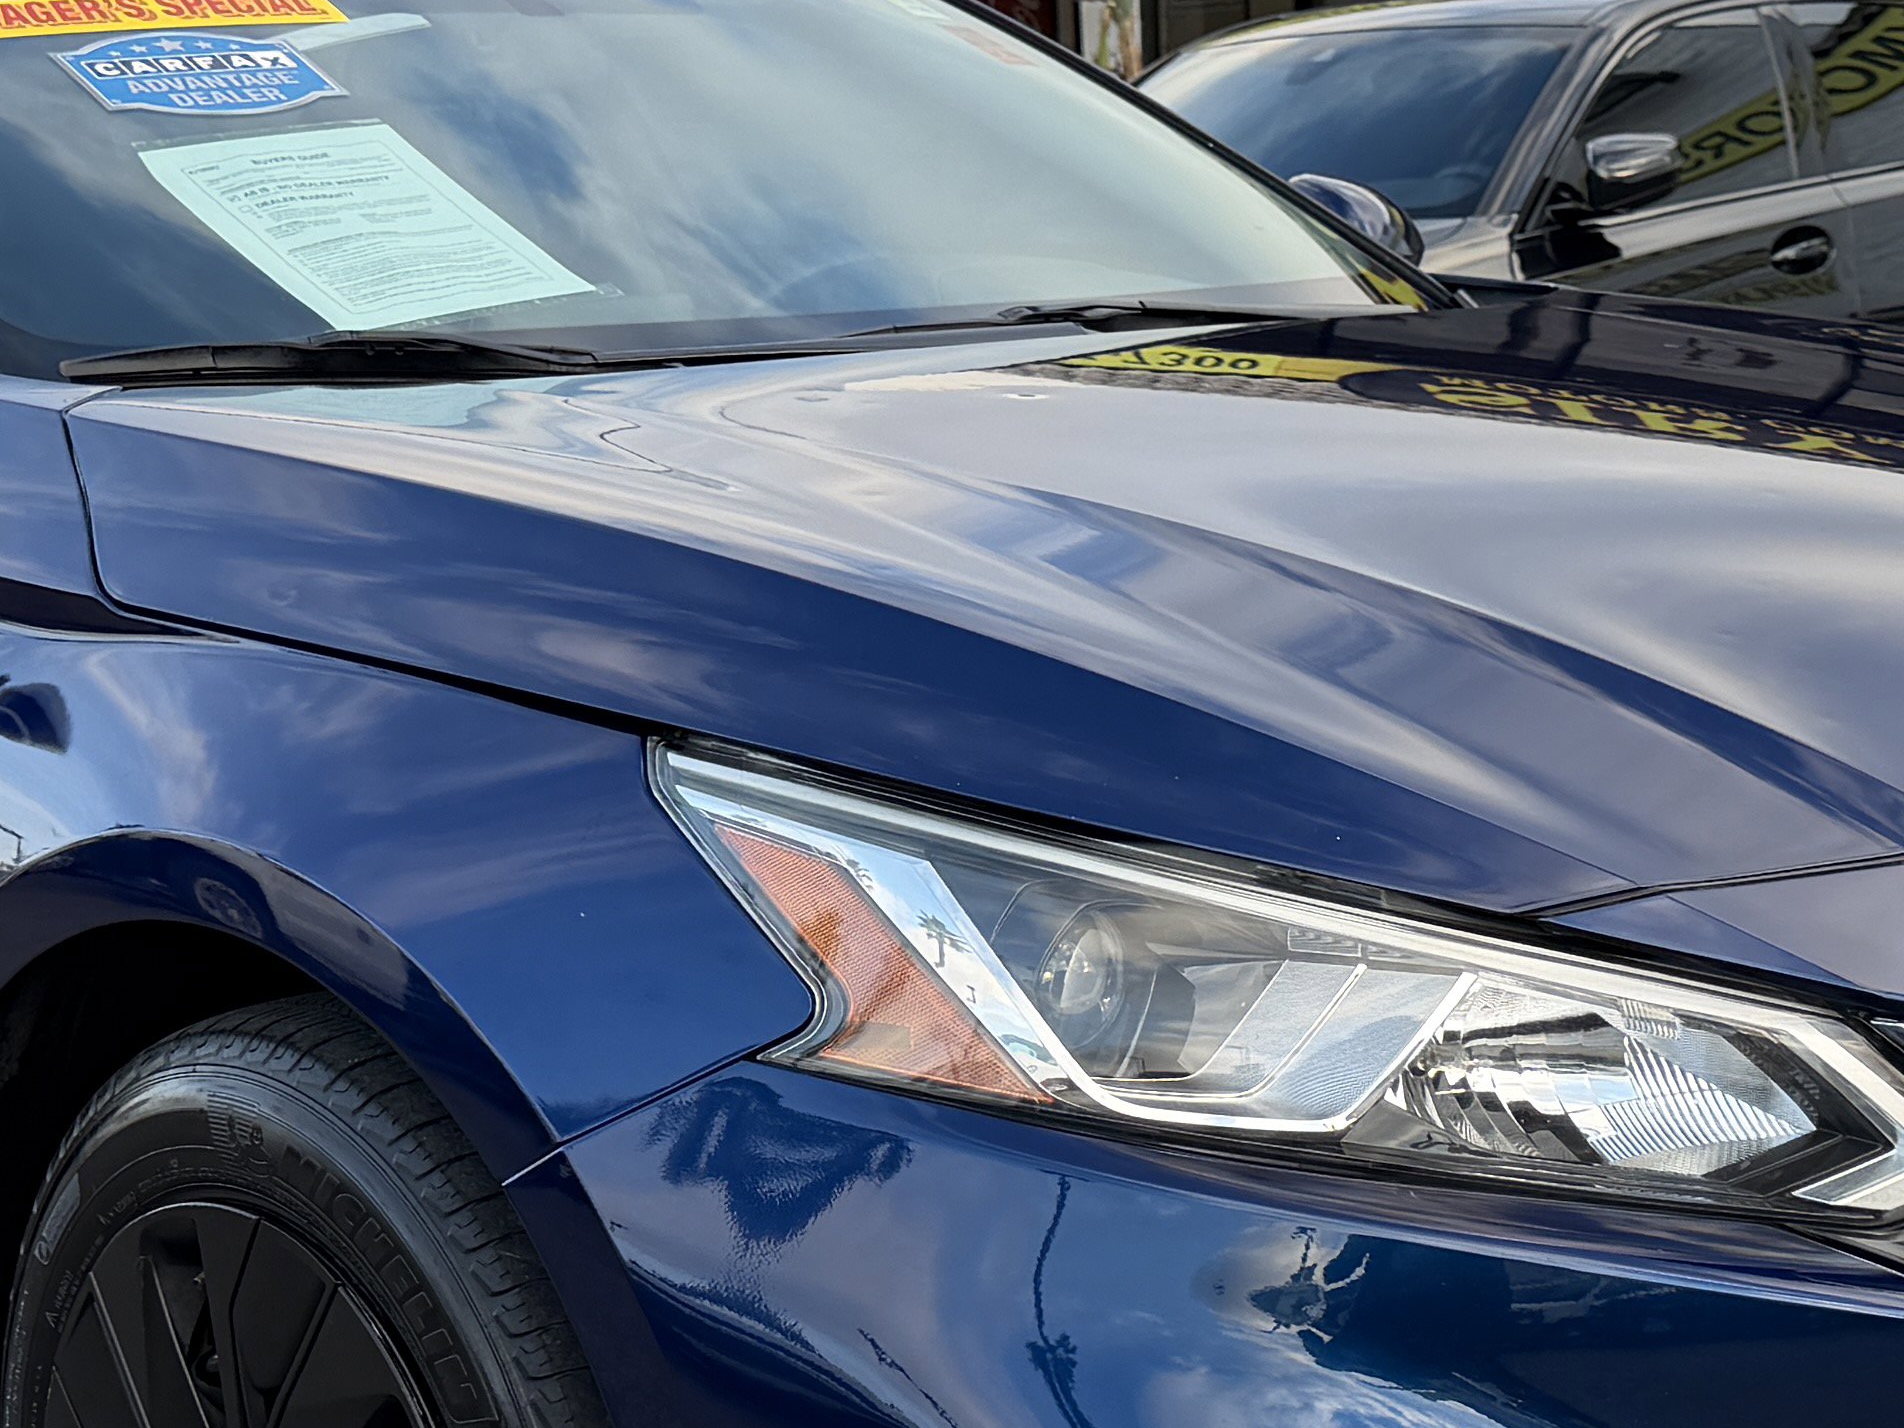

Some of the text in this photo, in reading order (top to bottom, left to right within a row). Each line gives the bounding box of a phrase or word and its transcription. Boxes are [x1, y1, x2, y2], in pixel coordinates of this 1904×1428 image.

[90, 52, 296, 78] CARFAX
[126, 71, 300, 95] ADVANTAGE
[167, 87, 289, 108] DEALER
[277, 1144, 482, 1410] MICHELIN
